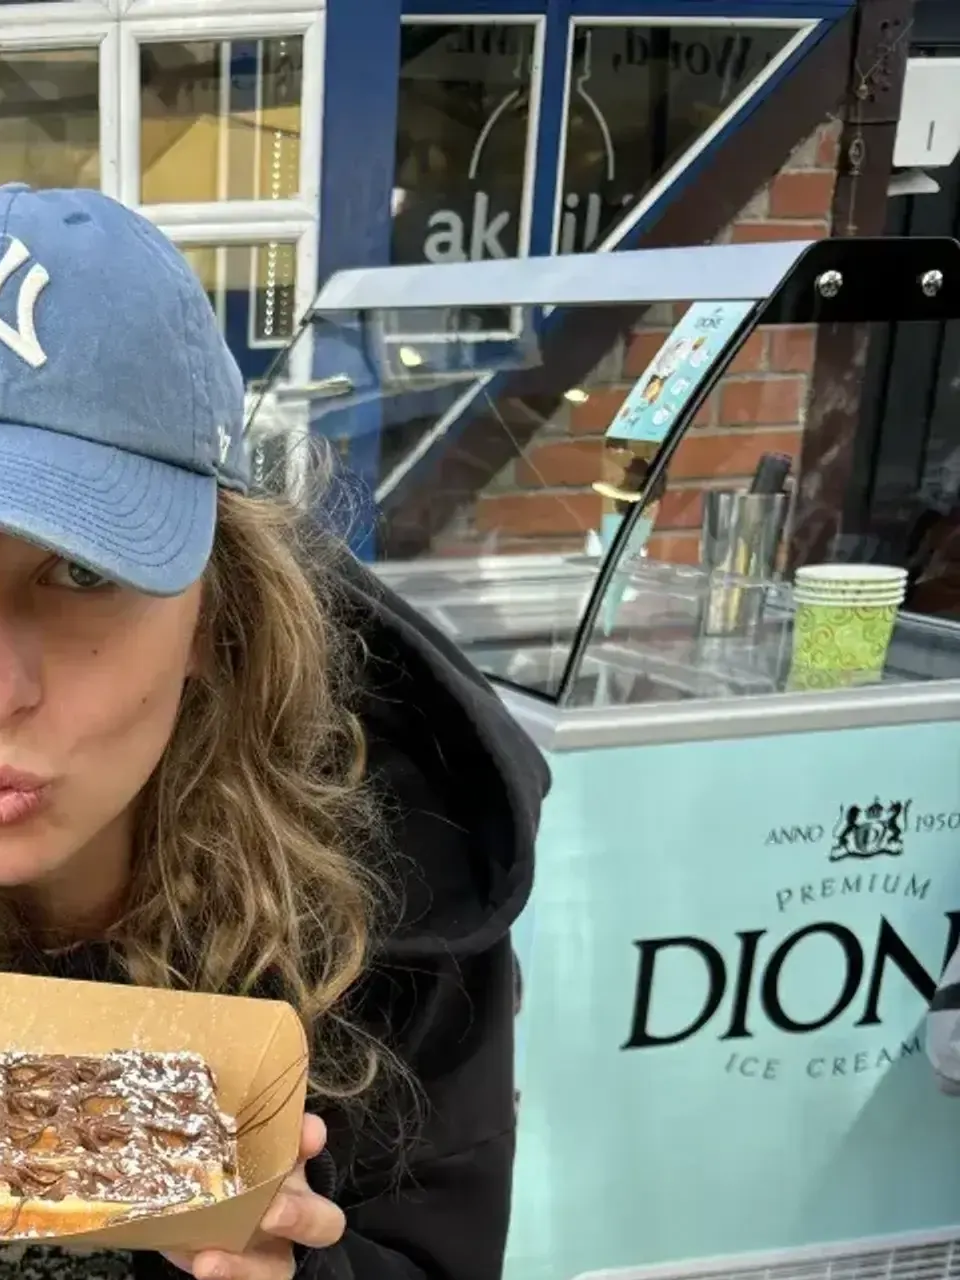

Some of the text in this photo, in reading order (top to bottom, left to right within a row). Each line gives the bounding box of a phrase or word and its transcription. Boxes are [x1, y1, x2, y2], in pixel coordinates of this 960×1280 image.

[764, 811, 960, 845] ANNO 1950
[776, 873, 932, 912] PREMIUM
[725, 1036, 925, 1080] ICE CREAM
